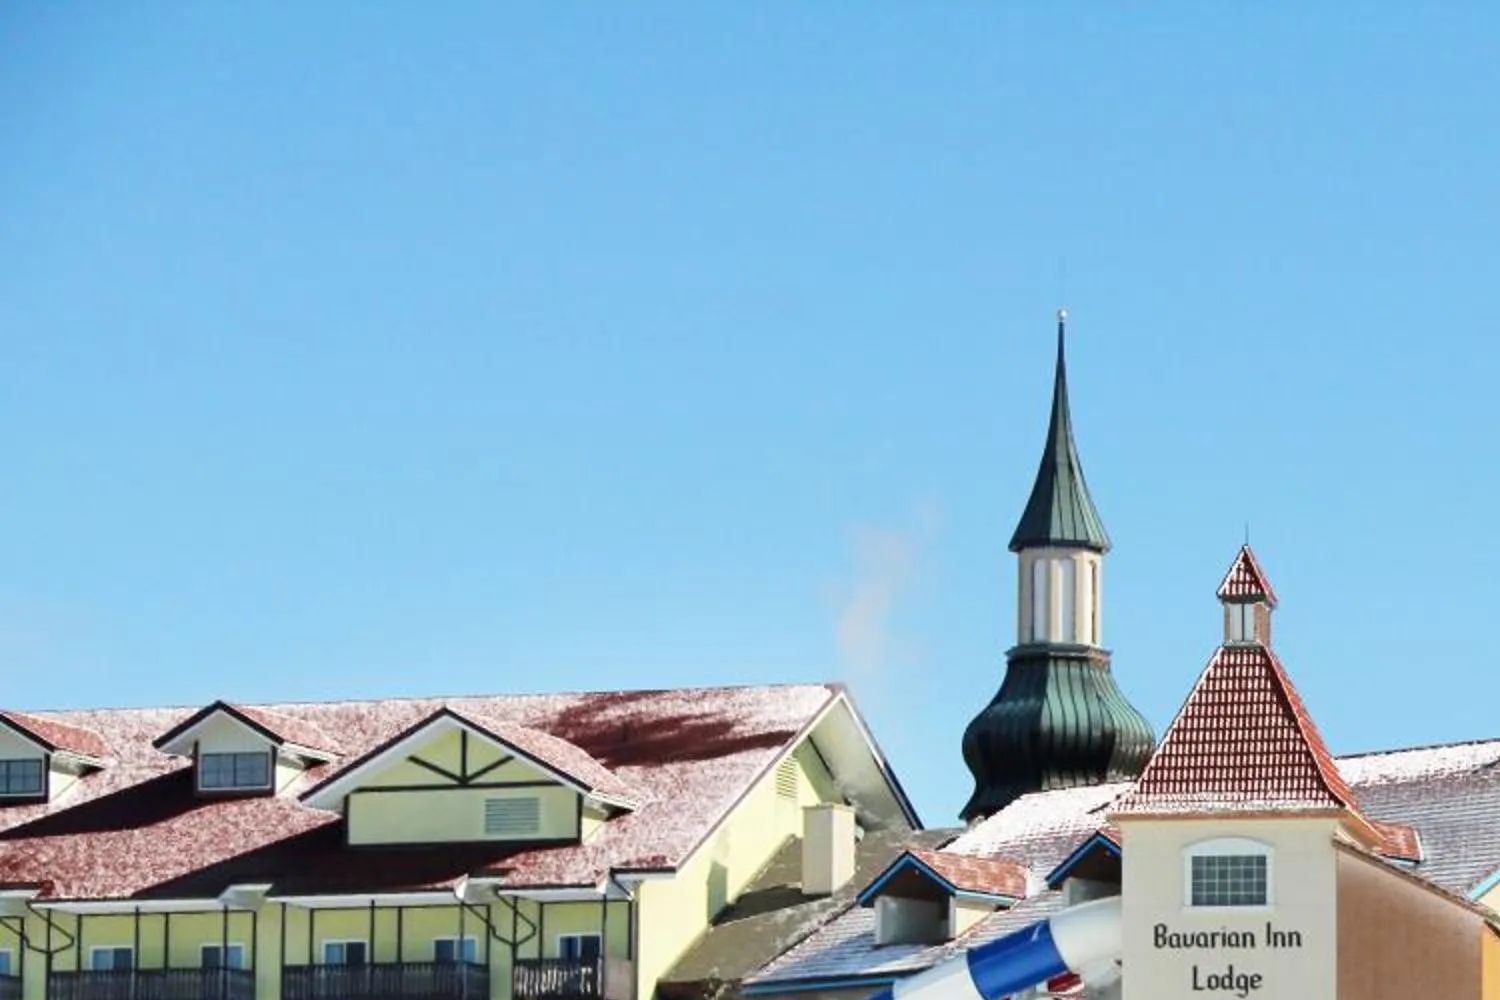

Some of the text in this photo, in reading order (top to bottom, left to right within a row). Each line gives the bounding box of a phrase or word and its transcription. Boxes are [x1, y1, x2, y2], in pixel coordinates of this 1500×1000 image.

[1153, 921, 1302, 949] Bavarian Inn
[1192, 964, 1263, 998] Lodge
